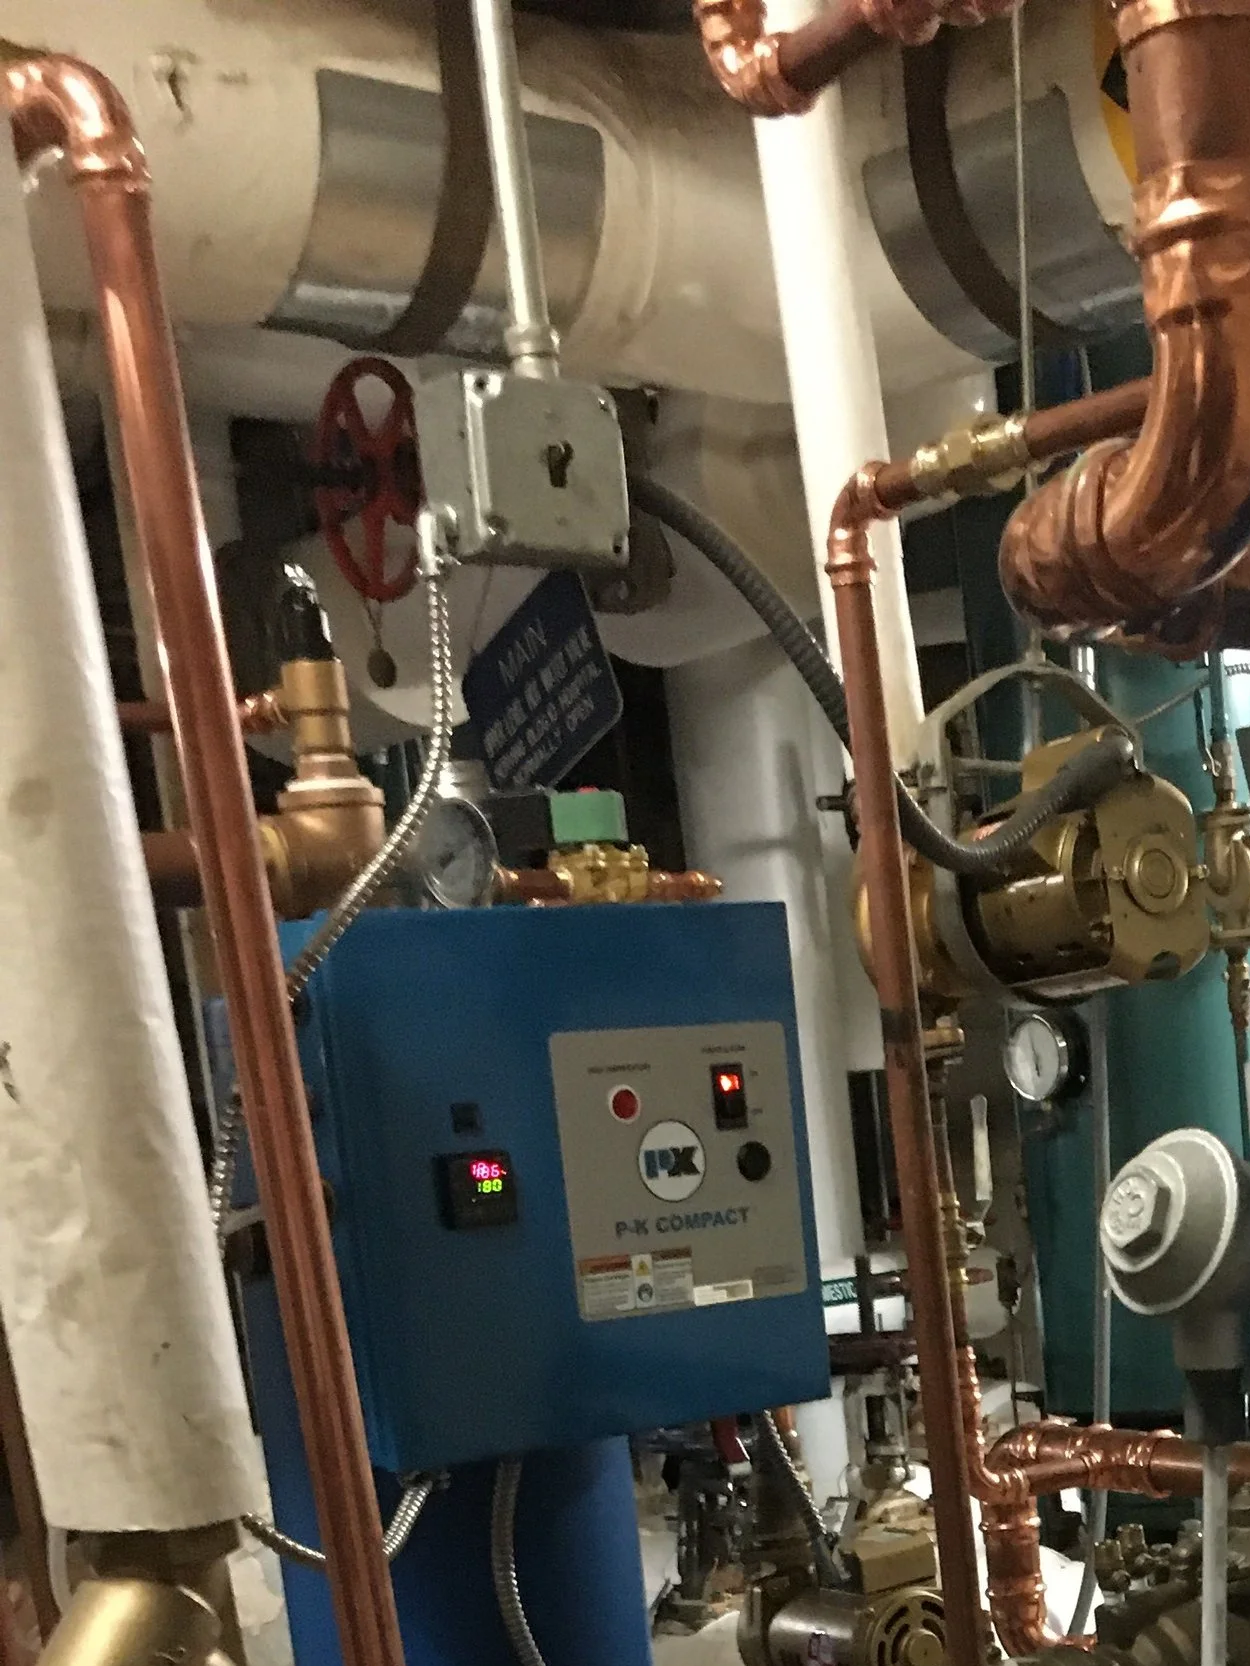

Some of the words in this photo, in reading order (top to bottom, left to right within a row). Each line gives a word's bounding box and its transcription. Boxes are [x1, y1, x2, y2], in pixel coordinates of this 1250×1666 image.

[499, 618, 546, 688] MAIN
[477, 1179, 503, 1193] 180
[615, 1219, 650, 1239] P-K
[655, 1206, 751, 1235] COMPACT
